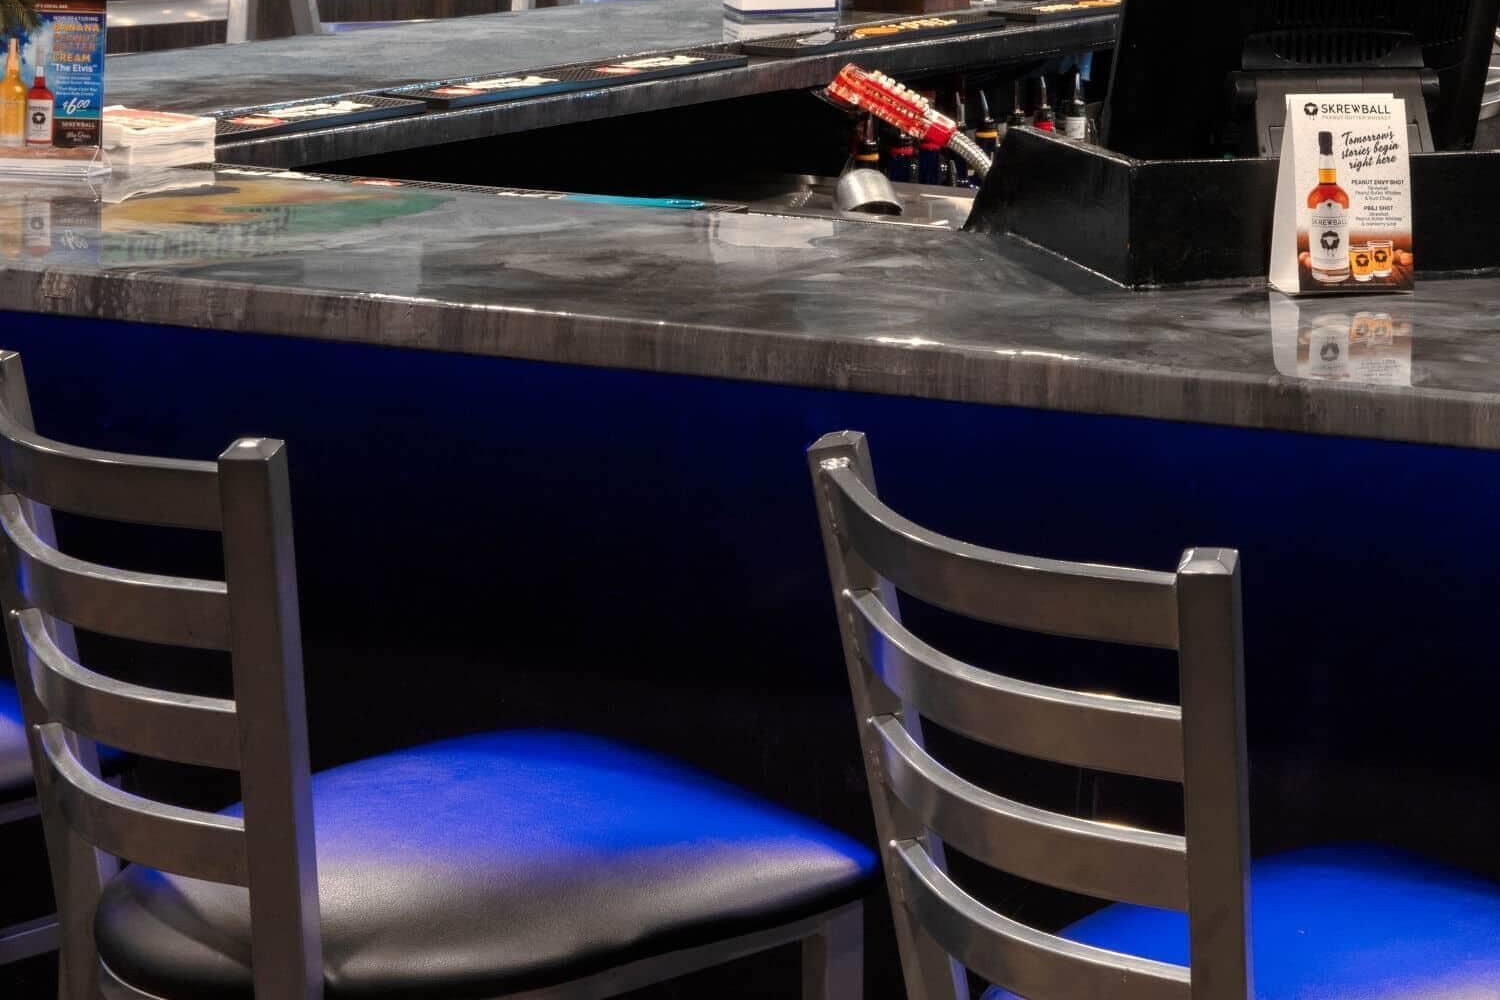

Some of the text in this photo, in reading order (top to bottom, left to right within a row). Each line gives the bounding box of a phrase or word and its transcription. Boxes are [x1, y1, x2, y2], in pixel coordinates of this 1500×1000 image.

[53, 23, 100, 33] BANANA
[53, 53, 91, 63] CREAM
[1320, 103, 1391, 114] SKREWBALL
[1341, 140, 1399, 160] stories begin
[1348, 155, 1397, 172] right here
